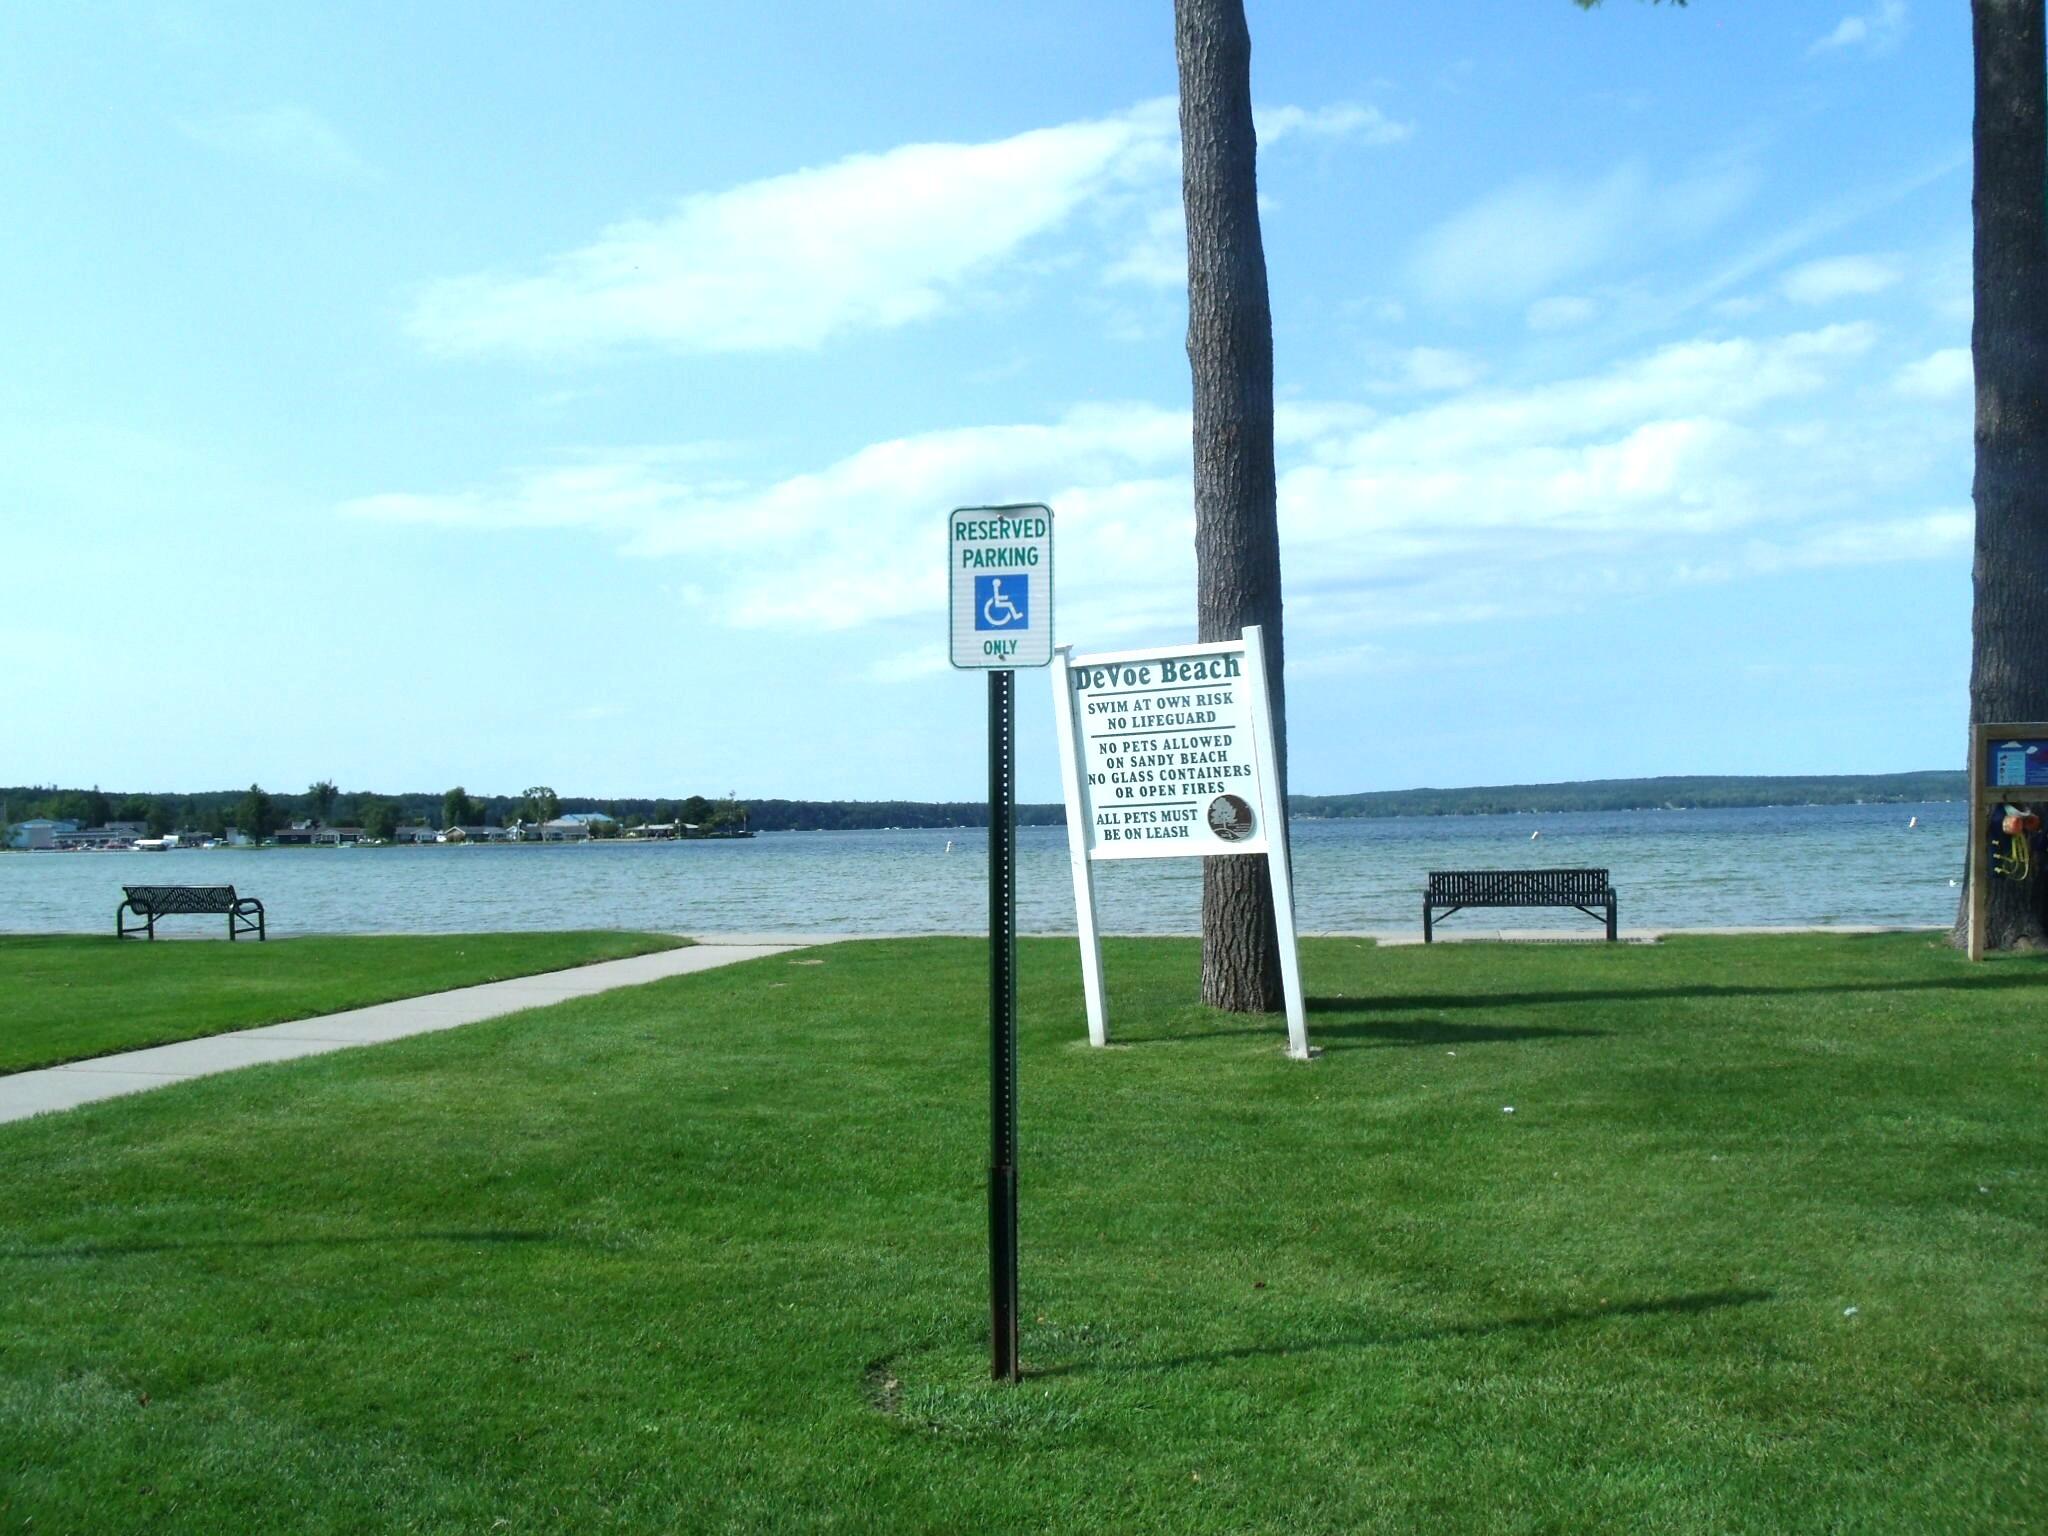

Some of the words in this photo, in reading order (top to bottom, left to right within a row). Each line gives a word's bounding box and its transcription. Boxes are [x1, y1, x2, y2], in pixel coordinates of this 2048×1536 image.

[956, 519, 1046, 541] RESERVED
[963, 547, 1038, 568] PARKING
[984, 640, 1018, 655] ONLY
[1075, 664, 1151, 690] DeVoe
[1160, 654, 1241, 683] Beach
[1088, 700, 1128, 714] SWIM
[1133, 698, 1151, 711] AT
[1156, 695, 1190, 709] OWN
[1196, 692, 1234, 706] RISK
[1108, 717, 1126, 730] NO
[1132, 711, 1216, 728] LIFEGUARD
[1099, 743, 1117, 754] NO
[1123, 739, 1157, 753] PETS
[1163, 734, 1232, 750] ALLOWED
[1107, 757, 1124, 769] ON
[1131, 754, 1174, 767] SANDY
[1181, 750, 1228, 764] BEACH
[1088, 773, 1105, 785] NO
[1111, 770, 1154, 784] GLASS
[1160, 764, 1251, 781] CONTAINERS
[1115, 787, 1134, 798] OR
[1140, 784, 1176, 797] OPEN
[1182, 781, 1225, 795] FIRES
[1096, 813, 1120, 825] ALL
[1124, 811, 1157, 824] PETS
[1161, 808, 1198, 823] MUST
[1104, 828, 1120, 841] BE
[1124, 827, 1142, 840] ON
[1146, 825, 1189, 839] LEASH
